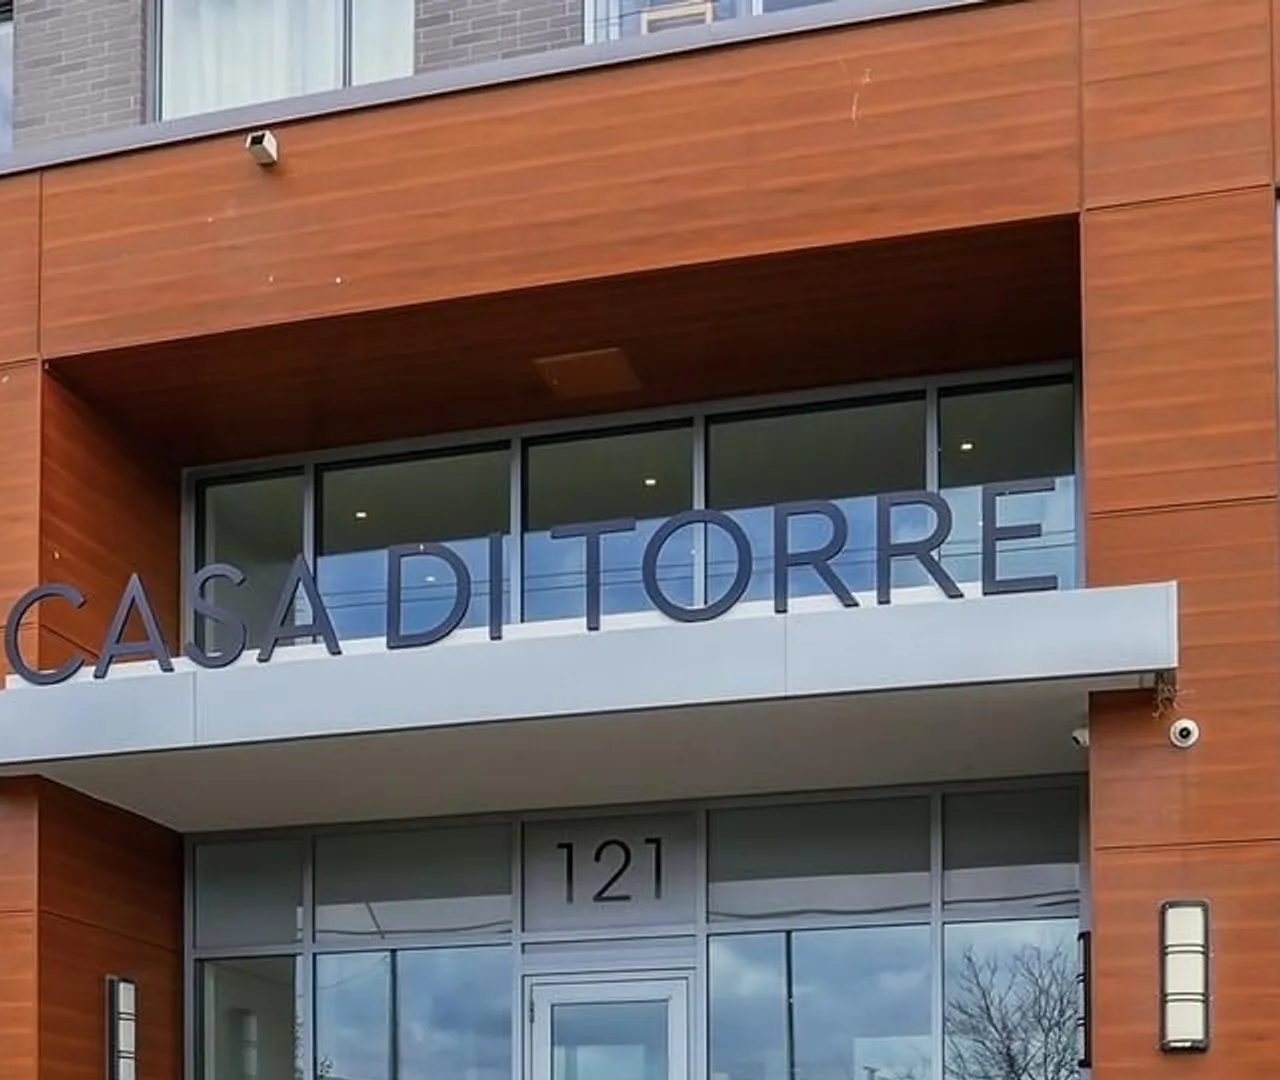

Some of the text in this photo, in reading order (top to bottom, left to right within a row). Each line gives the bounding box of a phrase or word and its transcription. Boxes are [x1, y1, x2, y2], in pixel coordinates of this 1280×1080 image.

[4, 479, 1059, 686] CASA DI TORRE
[556, 836, 666, 906] 121
